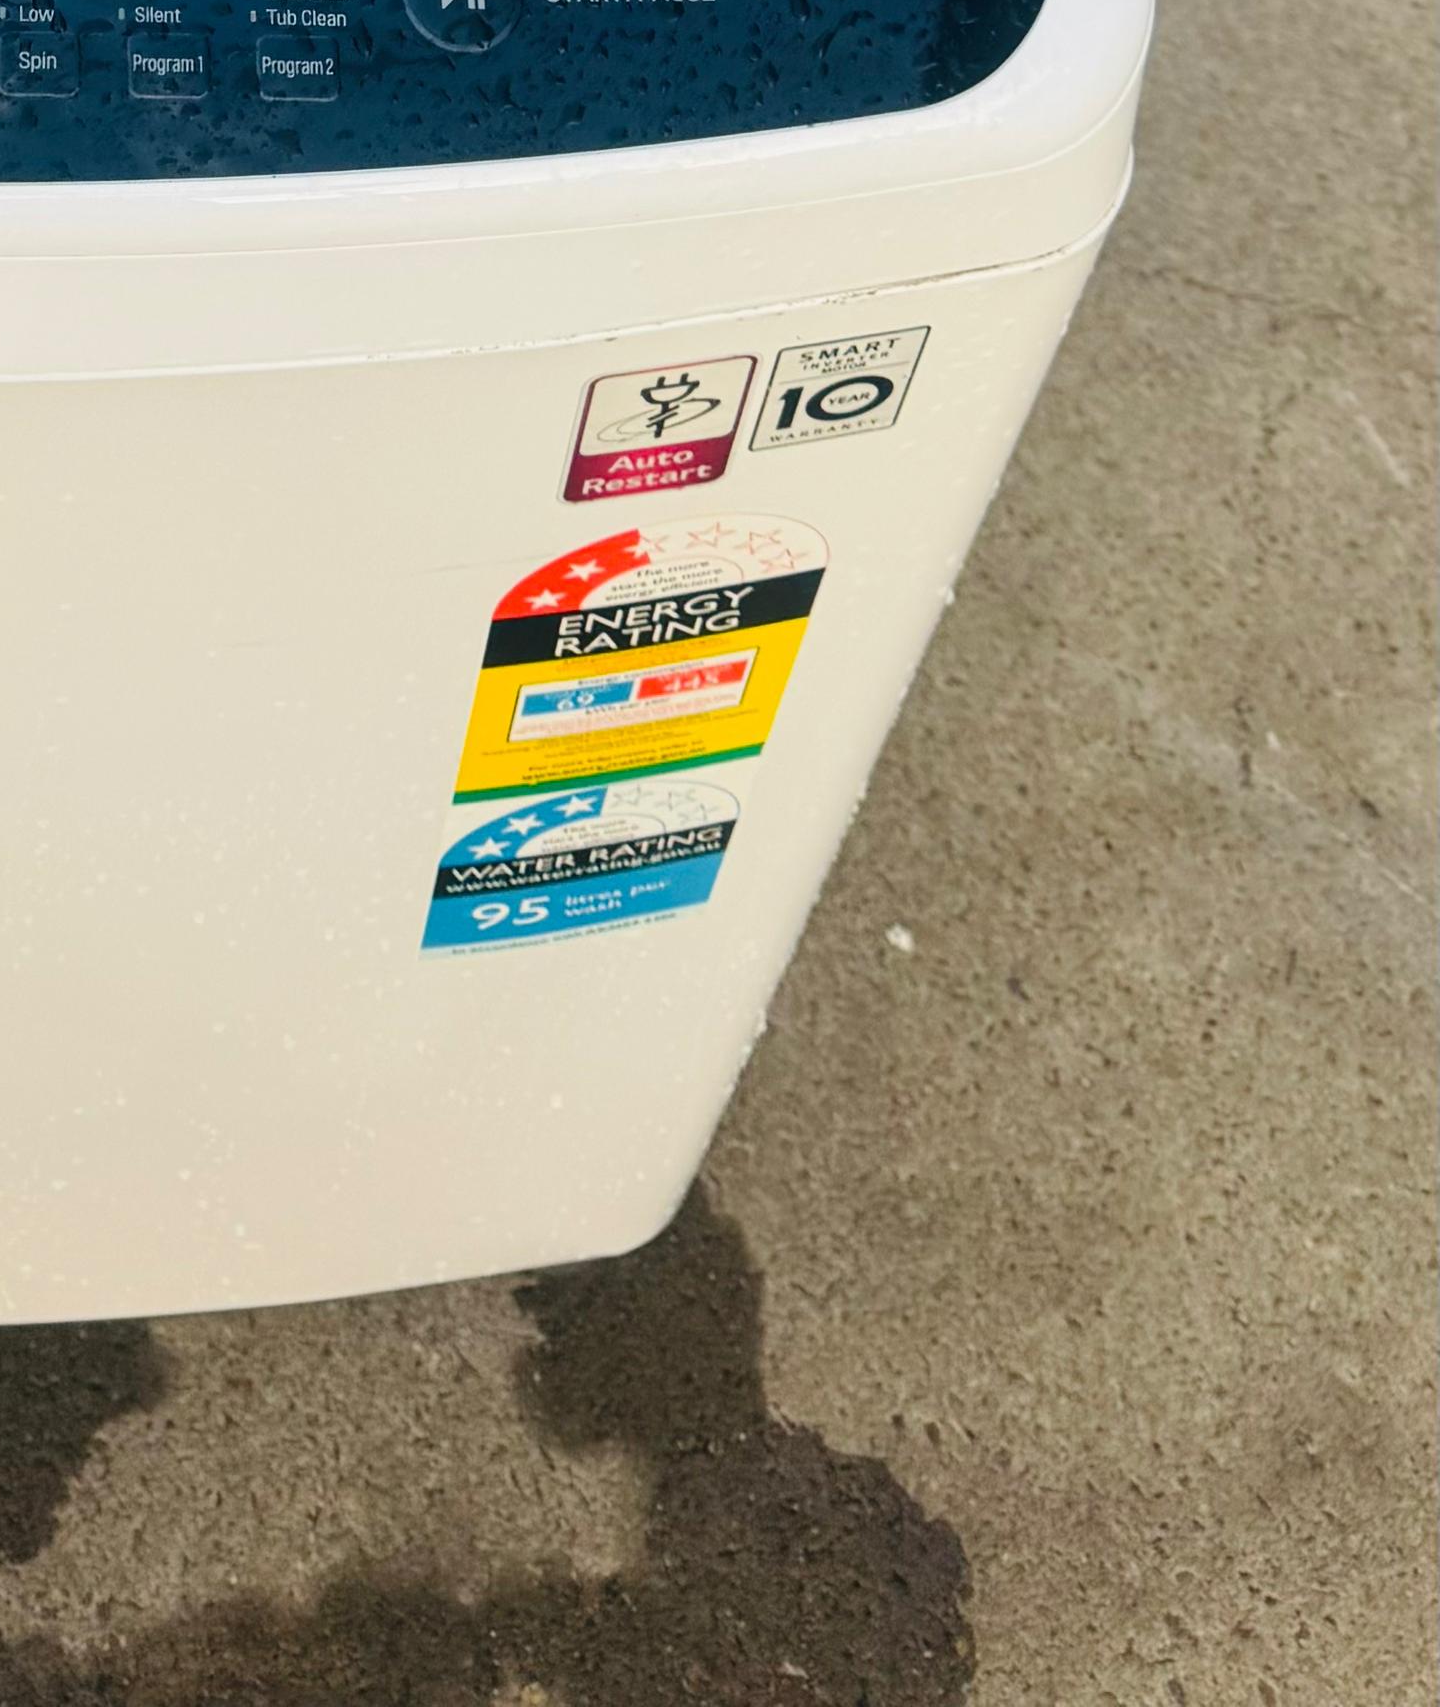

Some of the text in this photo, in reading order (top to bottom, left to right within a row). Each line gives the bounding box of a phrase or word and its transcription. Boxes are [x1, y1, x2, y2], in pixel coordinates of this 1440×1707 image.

[19, 5, 55, 23] Low
[133, 7, 182, 25] Silent
[265, 8, 347, 27] Tub Clean
[18, 51, 58, 72] Spin
[132, 53, 195, 76] Program
[799, 337, 902, 364] SMART
[802, 351, 890, 371] INVERTER
[775, 375, 895, 431] 10
[827, 391, 871, 406] YEAR
[769, 418, 880, 443] WARRANTY
[608, 449, 694, 473] Auto
[581, 464, 712, 496] Restart
[558, 586, 755, 636] ENERGY
[554, 609, 742, 657] RATING
[451, 852, 576, 882] WATER
[588, 825, 724, 864] RATING
[470, 895, 551, 931] 95
